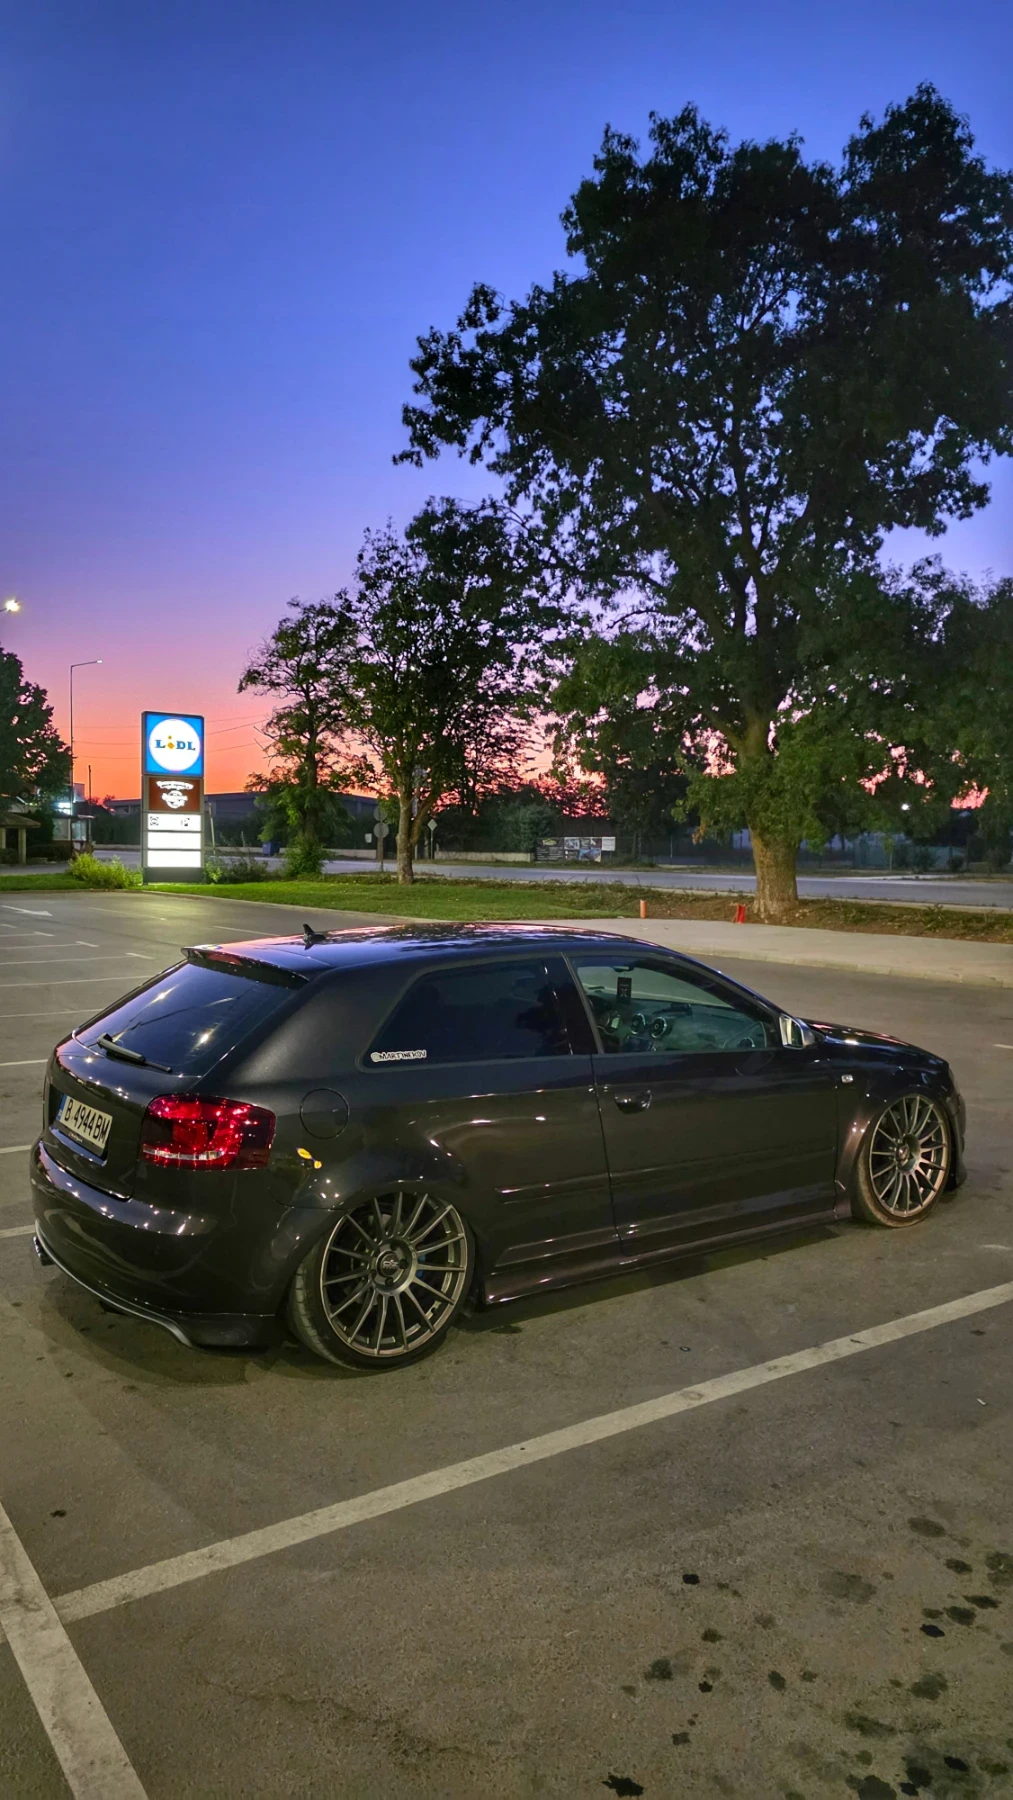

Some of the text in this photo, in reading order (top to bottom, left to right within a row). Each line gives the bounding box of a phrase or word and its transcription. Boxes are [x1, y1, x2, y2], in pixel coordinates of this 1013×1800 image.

[64, 1098, 111, 1144] B 4944 BM
